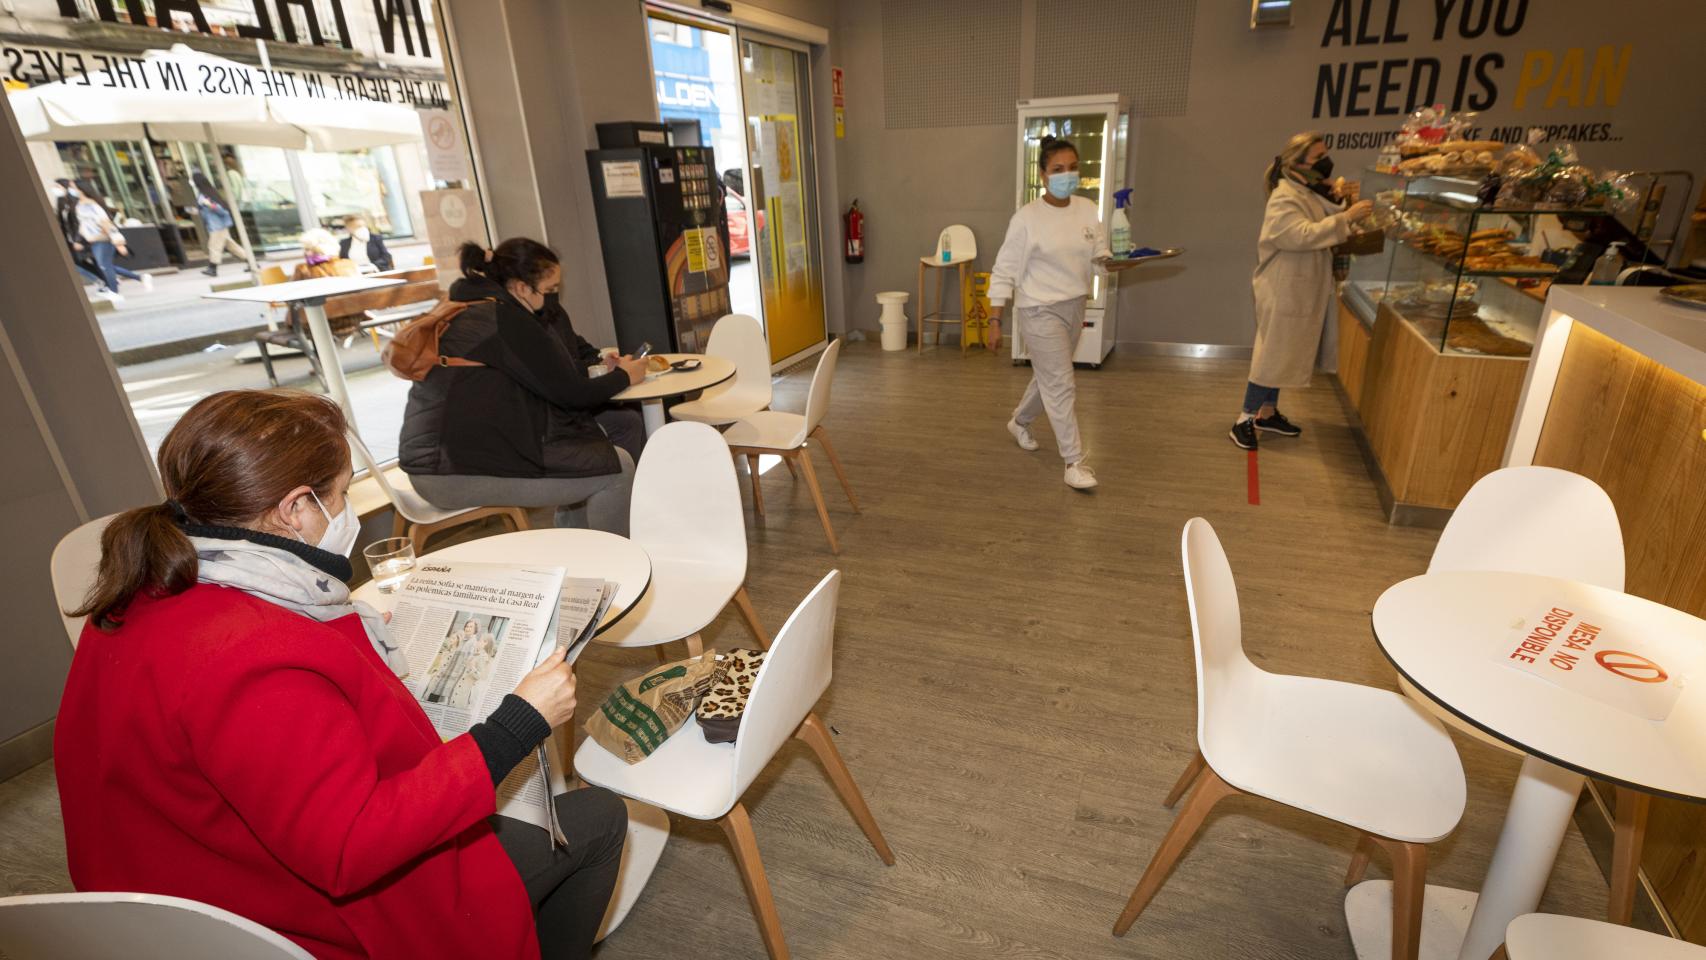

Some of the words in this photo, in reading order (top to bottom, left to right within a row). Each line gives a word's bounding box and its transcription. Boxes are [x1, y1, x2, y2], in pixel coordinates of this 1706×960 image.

[1321, 0, 1409, 47] ALL
[1432, 0, 1530, 41] YOU
[1312, 57, 1441, 119] NEED
[1451, 53, 1505, 112] IS
[1512, 43, 1634, 112] PAN
[1490, 126, 1522, 144] AND
[452, 590, 487, 600] familiares
[488, 595, 498, 603] de
[498, 596, 506, 604] la
[506, 598, 522, 606] Casa
[523, 600, 540, 609] Real
[464, 584, 499, 594] mantiene
[507, 590, 535, 599] margen
[535, 593, 545, 601] de
[1510, 607, 1574, 664] DISPONIBLE
[1561, 621, 1602, 652] MESA
[1549, 650, 1580, 671] NO
